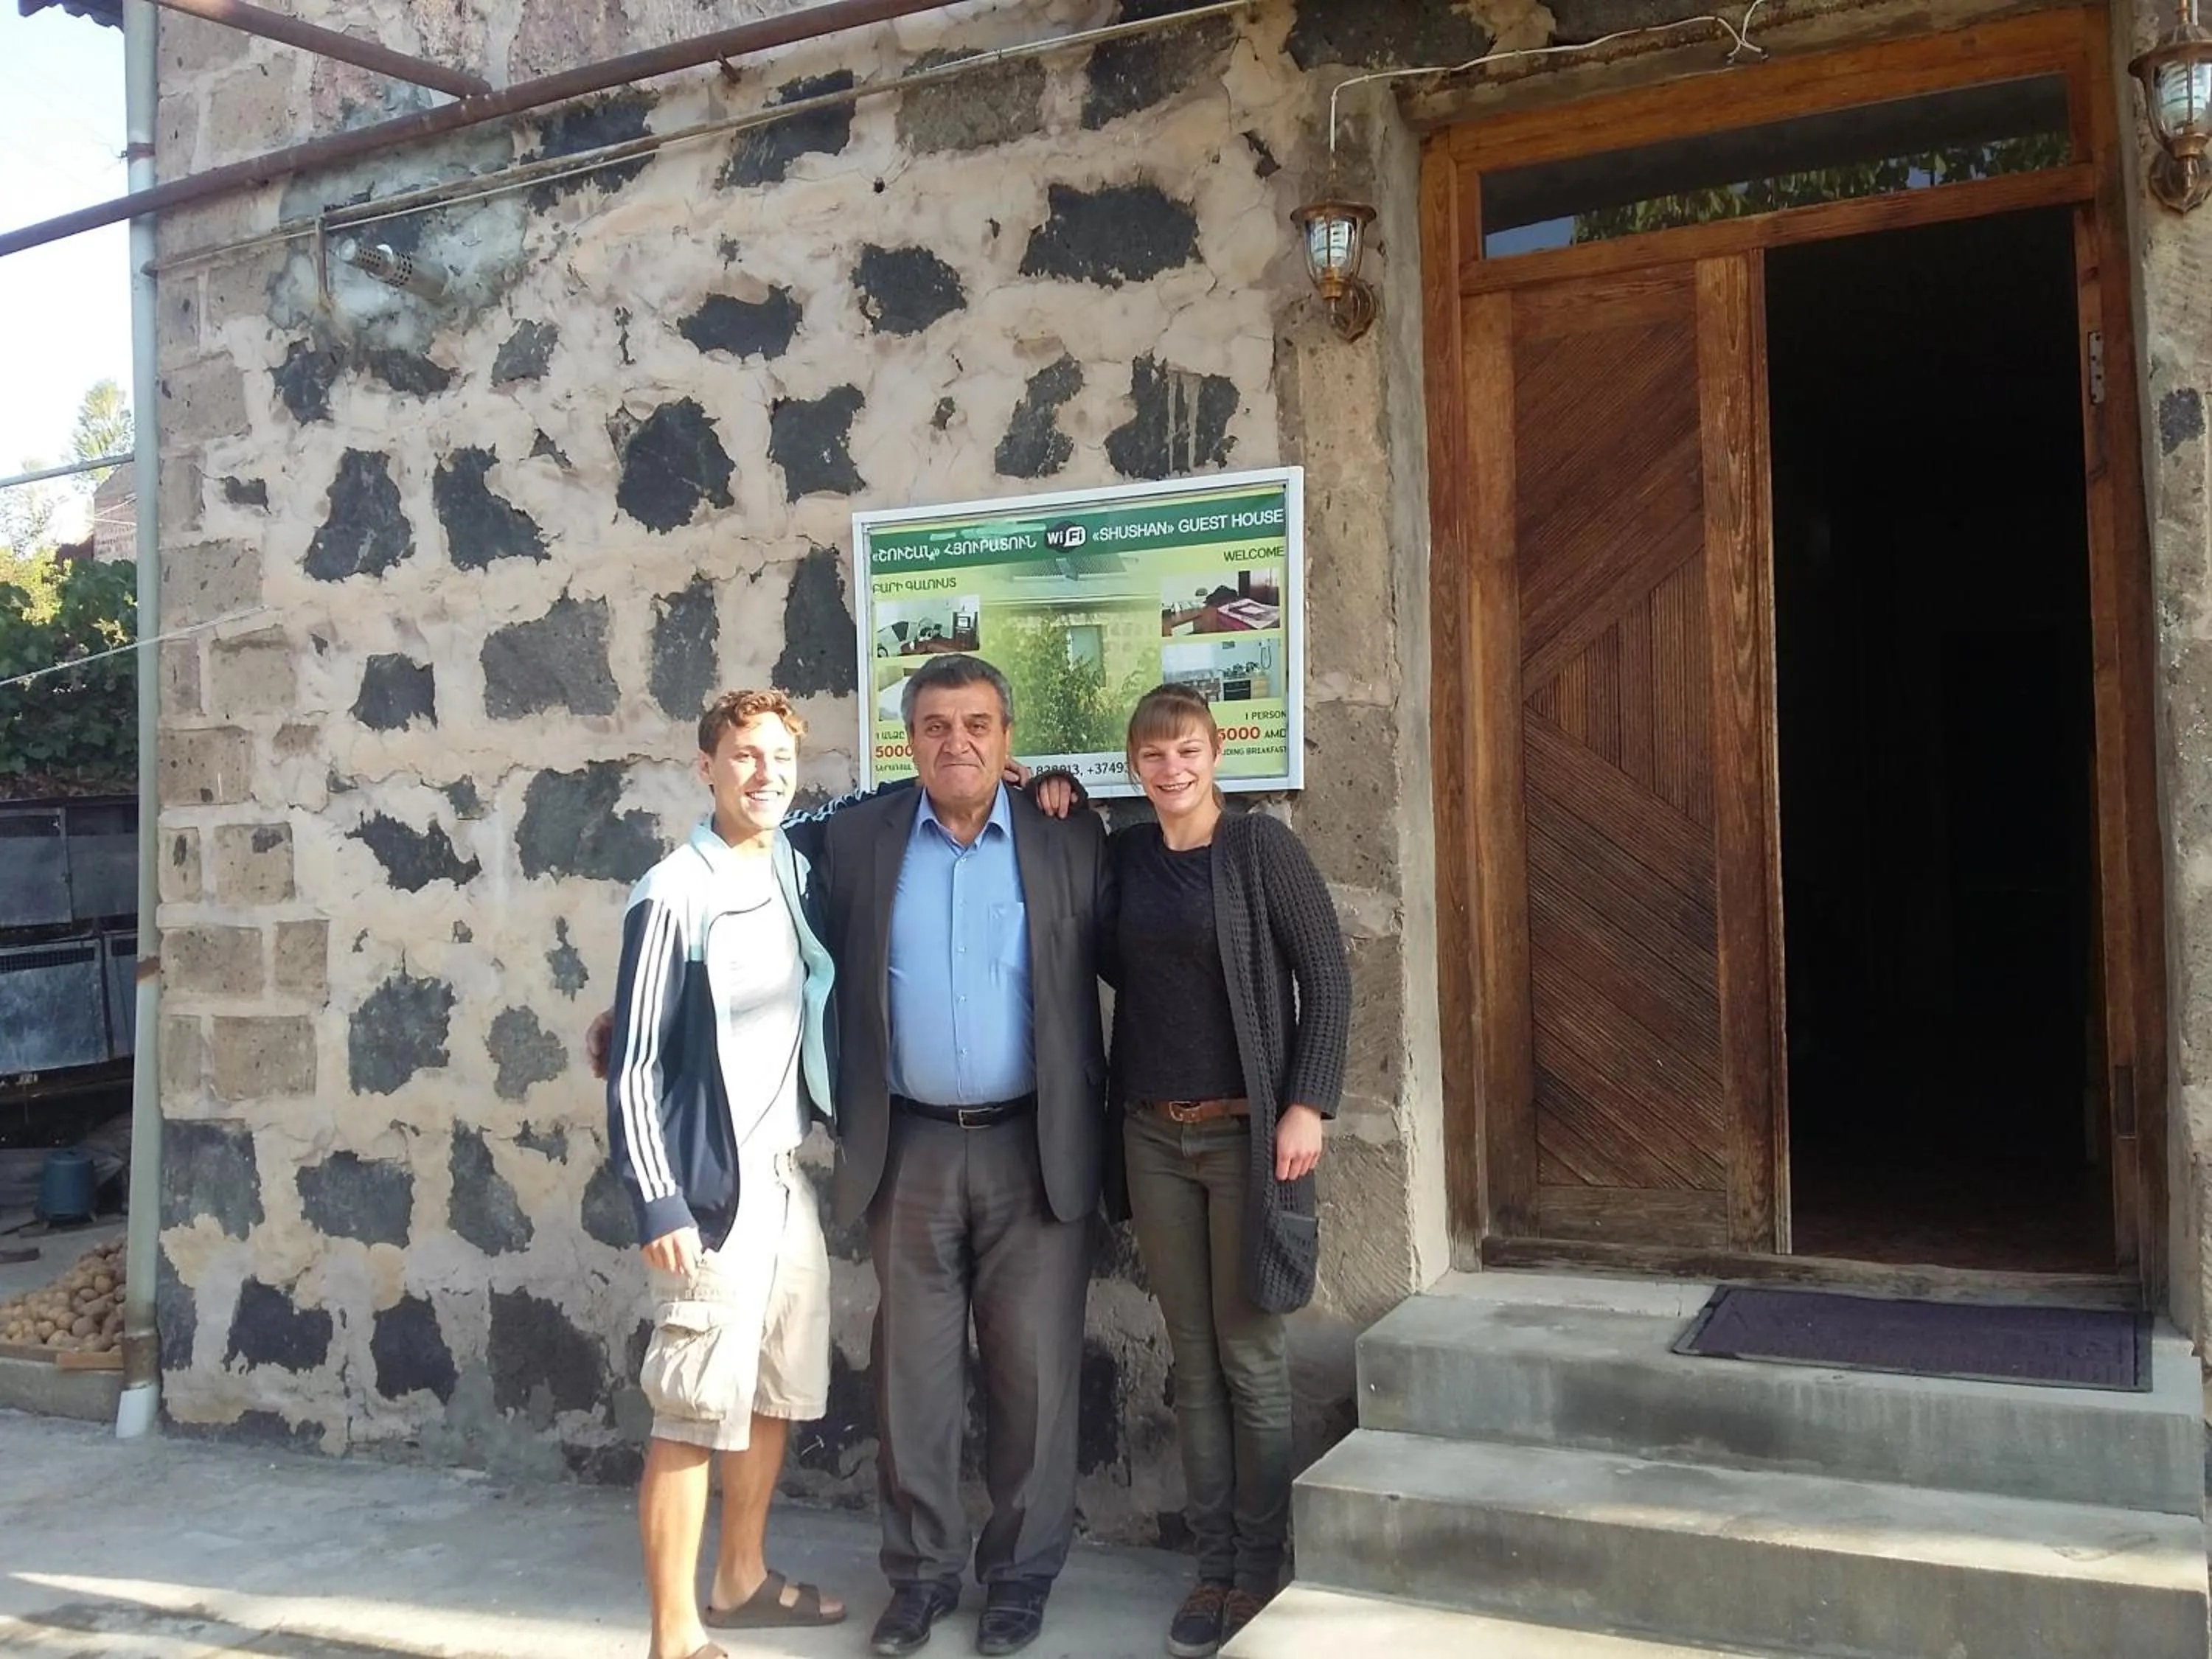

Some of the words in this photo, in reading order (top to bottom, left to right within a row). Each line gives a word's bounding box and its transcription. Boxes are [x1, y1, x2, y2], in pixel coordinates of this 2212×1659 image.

[1178, 515, 1228, 534] GUEST
[1231, 508, 1284, 528] HOUSE
[1223, 546, 1285, 562] WELCOME
[1251, 710, 1287, 720] PERSON
[875, 744, 914, 759] 5000
